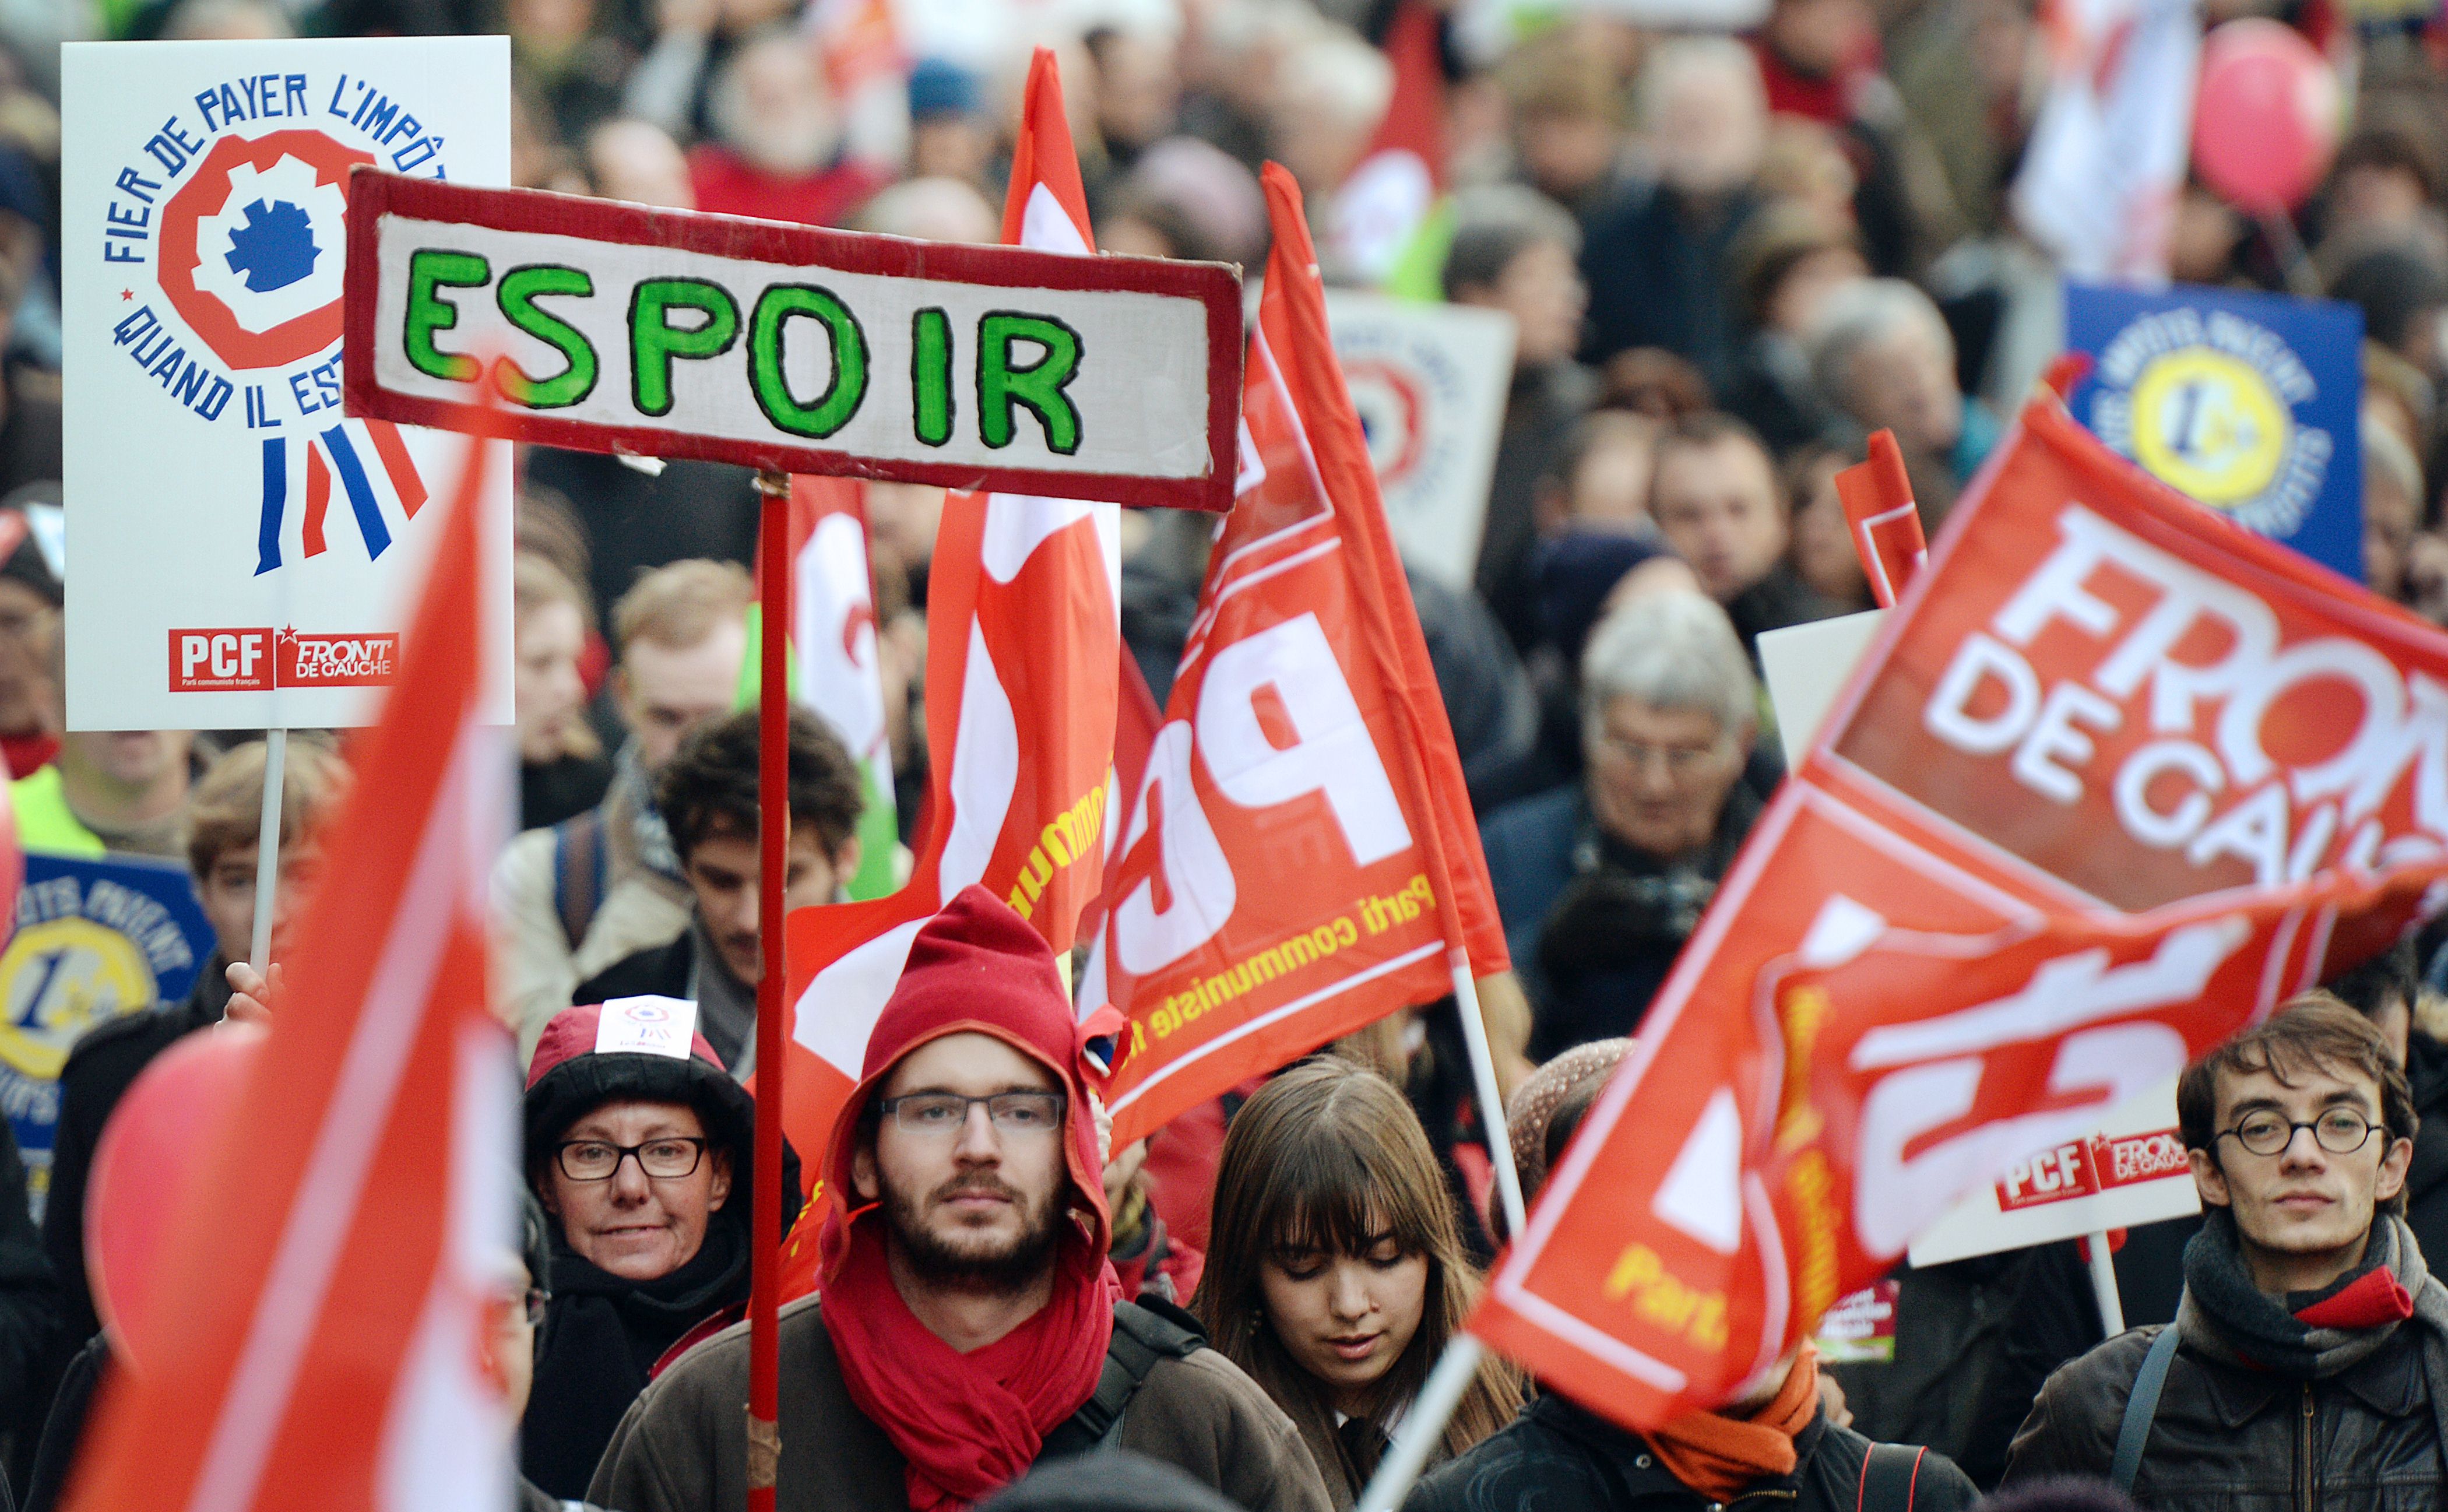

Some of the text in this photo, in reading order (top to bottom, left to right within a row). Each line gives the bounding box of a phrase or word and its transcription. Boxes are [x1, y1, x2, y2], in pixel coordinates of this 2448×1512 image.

[104, 167, 161, 263] FIER
[143, 115, 205, 178] DE
[195, 73, 308, 132] PAYER
[113, 305, 343, 428] QUAND IL ES
[403, 247, 1085, 455] ESPOIR
[181, 634, 263, 678] PCF
[296, 639, 393, 664] FRONT
[296, 659, 391, 678] DE GAUCHE
[1991, 500, 2448, 831] FRON
[1925, 631, 2123, 806] DE
[2005, 1144, 2082, 1198] PCF
[2112, 1134, 2186, 1165] FRON
[2115, 1151, 2189, 1180] DE GAUC
